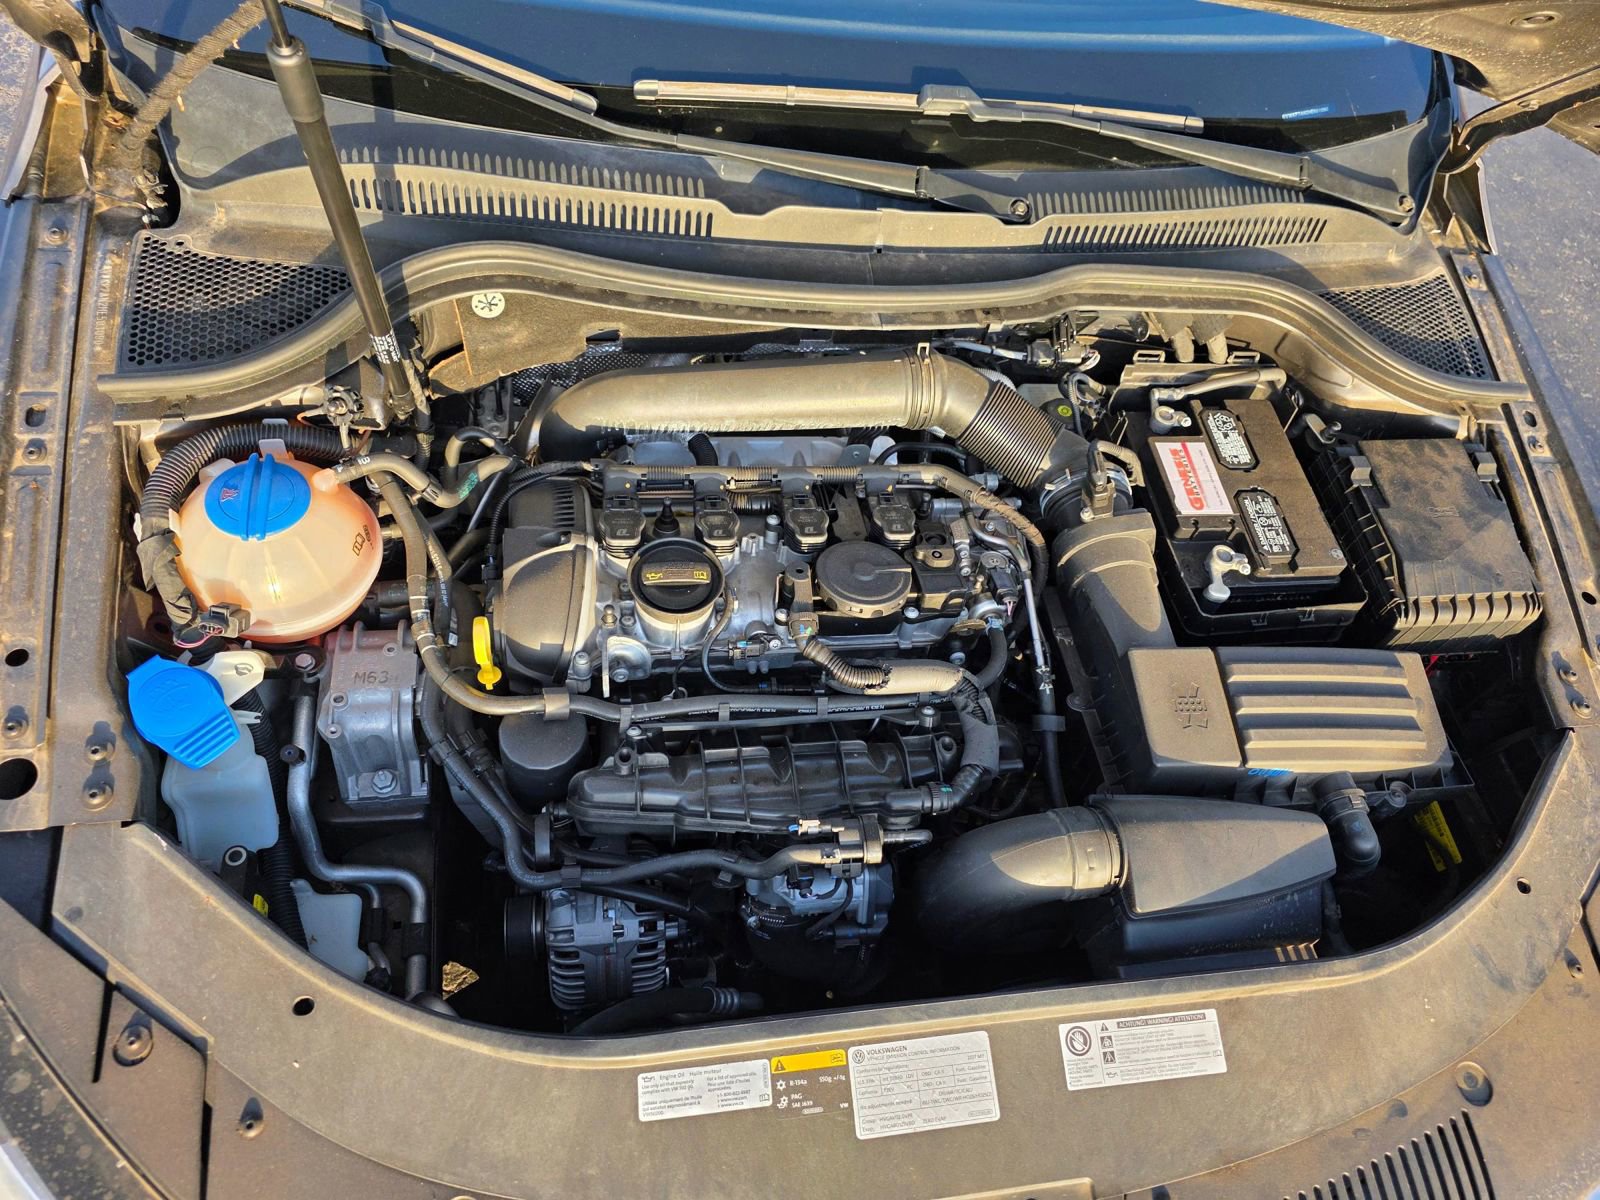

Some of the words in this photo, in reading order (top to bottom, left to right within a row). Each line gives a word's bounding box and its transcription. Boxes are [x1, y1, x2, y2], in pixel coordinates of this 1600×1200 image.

[1178, 449, 1200, 496] BATTERIES
[1244, 500, 1255, 518] POISON
[353, 670, 389, 684] M63
[1146, 1016, 1173, 1025] WARNING!
[865, 1045, 907, 1054] VOLKSWAGEN
